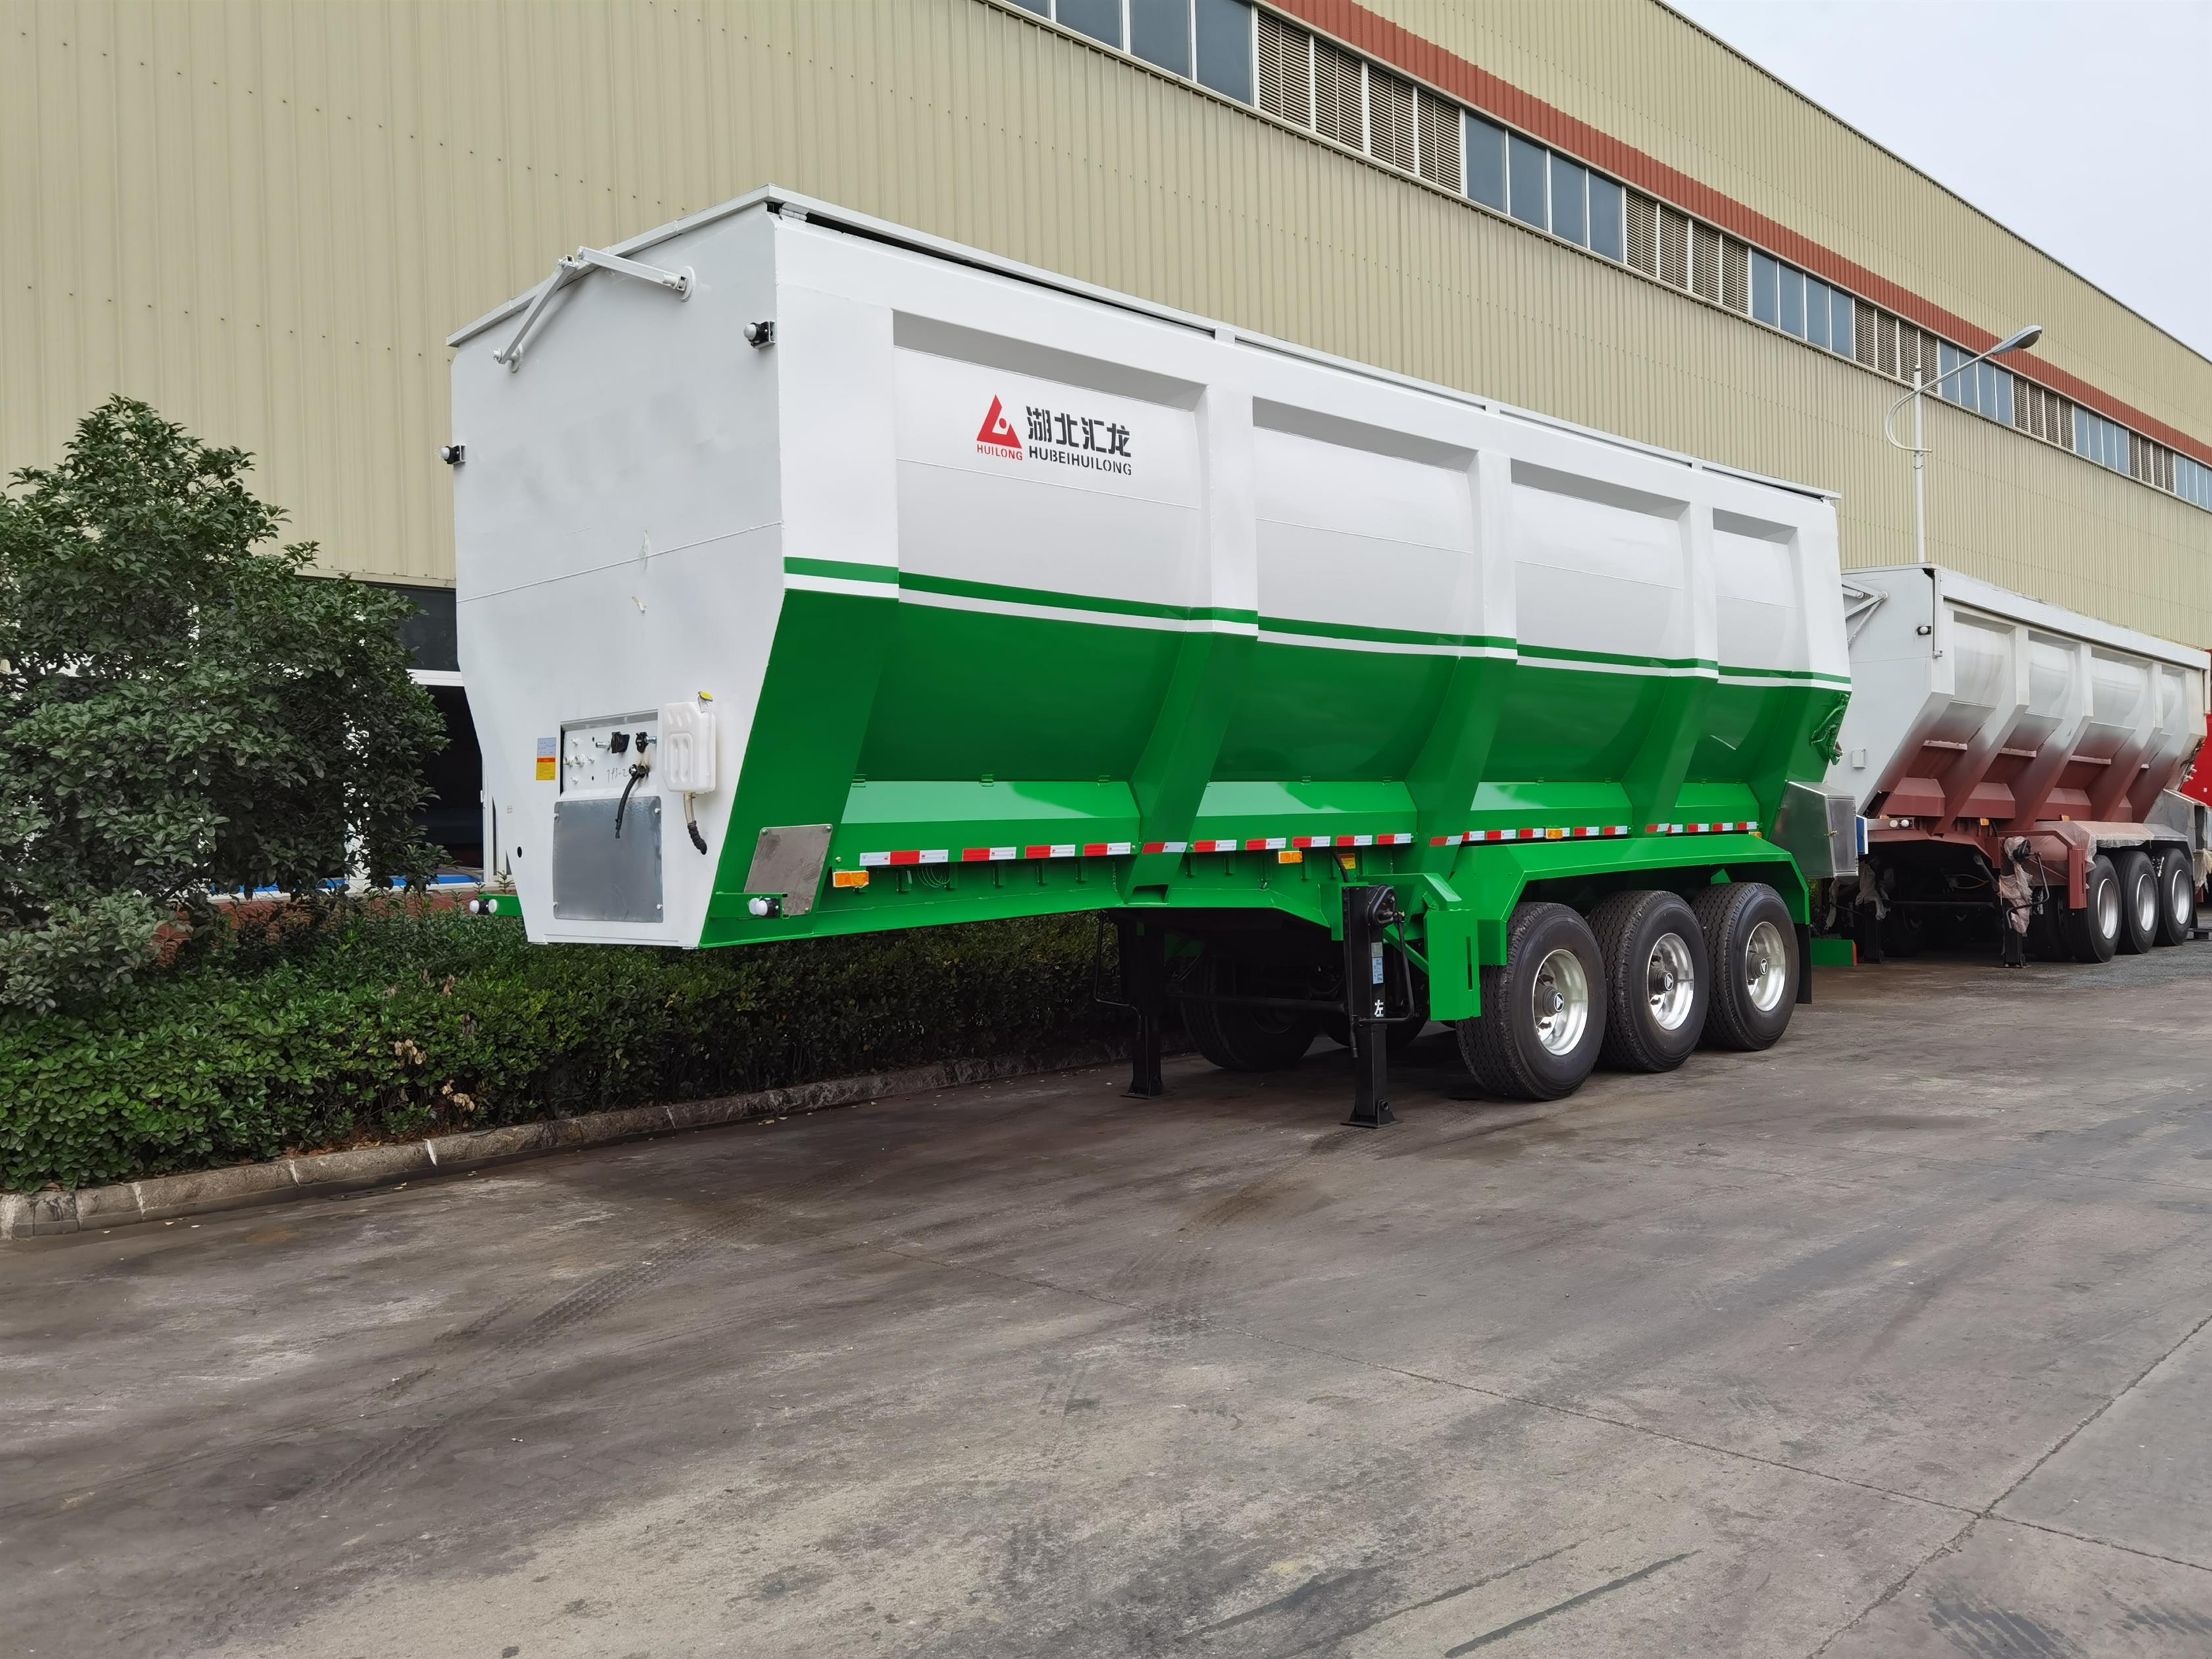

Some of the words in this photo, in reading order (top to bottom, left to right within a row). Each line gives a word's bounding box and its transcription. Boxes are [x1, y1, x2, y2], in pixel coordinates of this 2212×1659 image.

[1026, 405, 1131, 457] 湖北汇龙
[977, 444, 1023, 461] HUILONG
[1029, 446, 1131, 475] HUBEIHUILONG
[1374, 1000, 1384, 1017] 左
